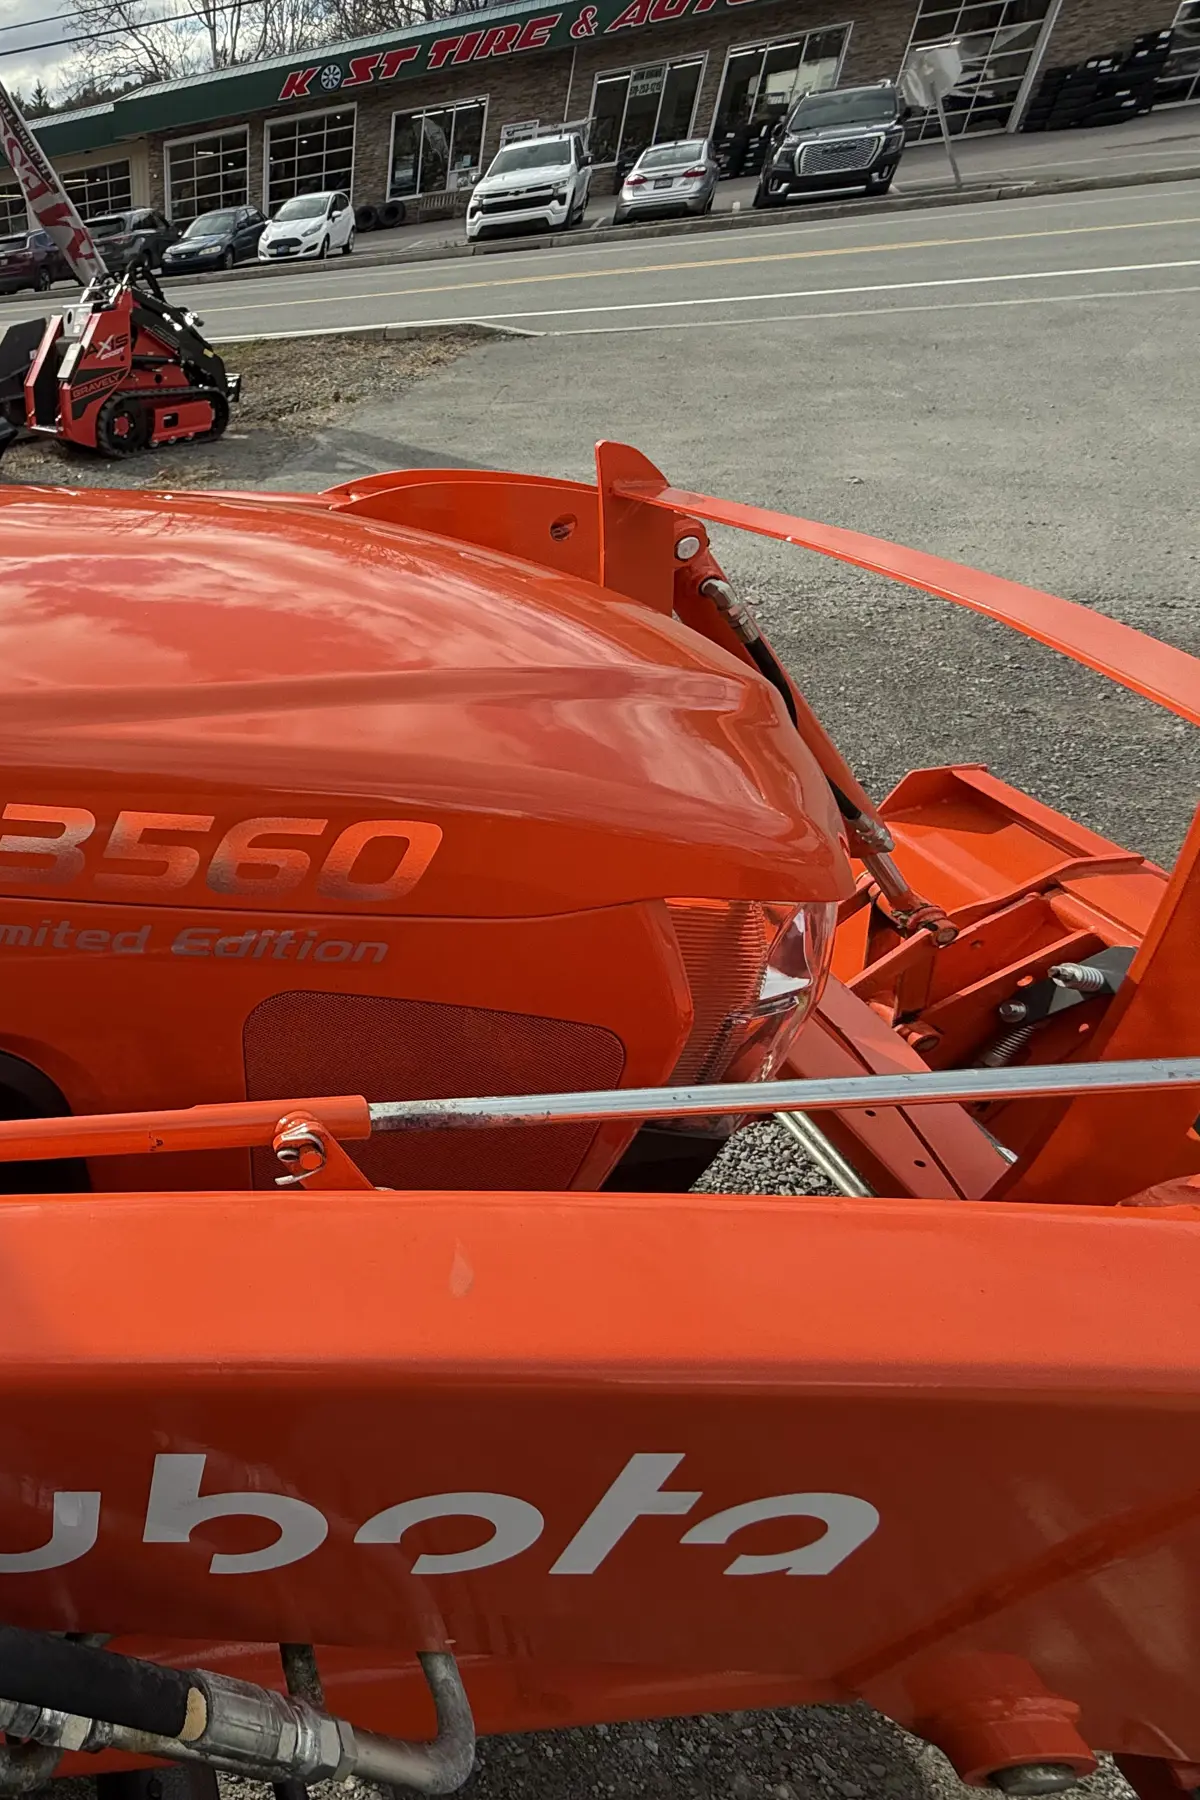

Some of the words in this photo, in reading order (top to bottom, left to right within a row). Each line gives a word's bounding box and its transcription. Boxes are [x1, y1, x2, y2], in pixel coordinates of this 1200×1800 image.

[427, 13, 562, 69] TIRE
[569, 5, 599, 40] &
[13, 121, 49, 177] Helping
[84, 333, 128, 360] AXIS
[73, 373, 120, 397] GRAVELY
[170, 926, 389, 964] Edition
